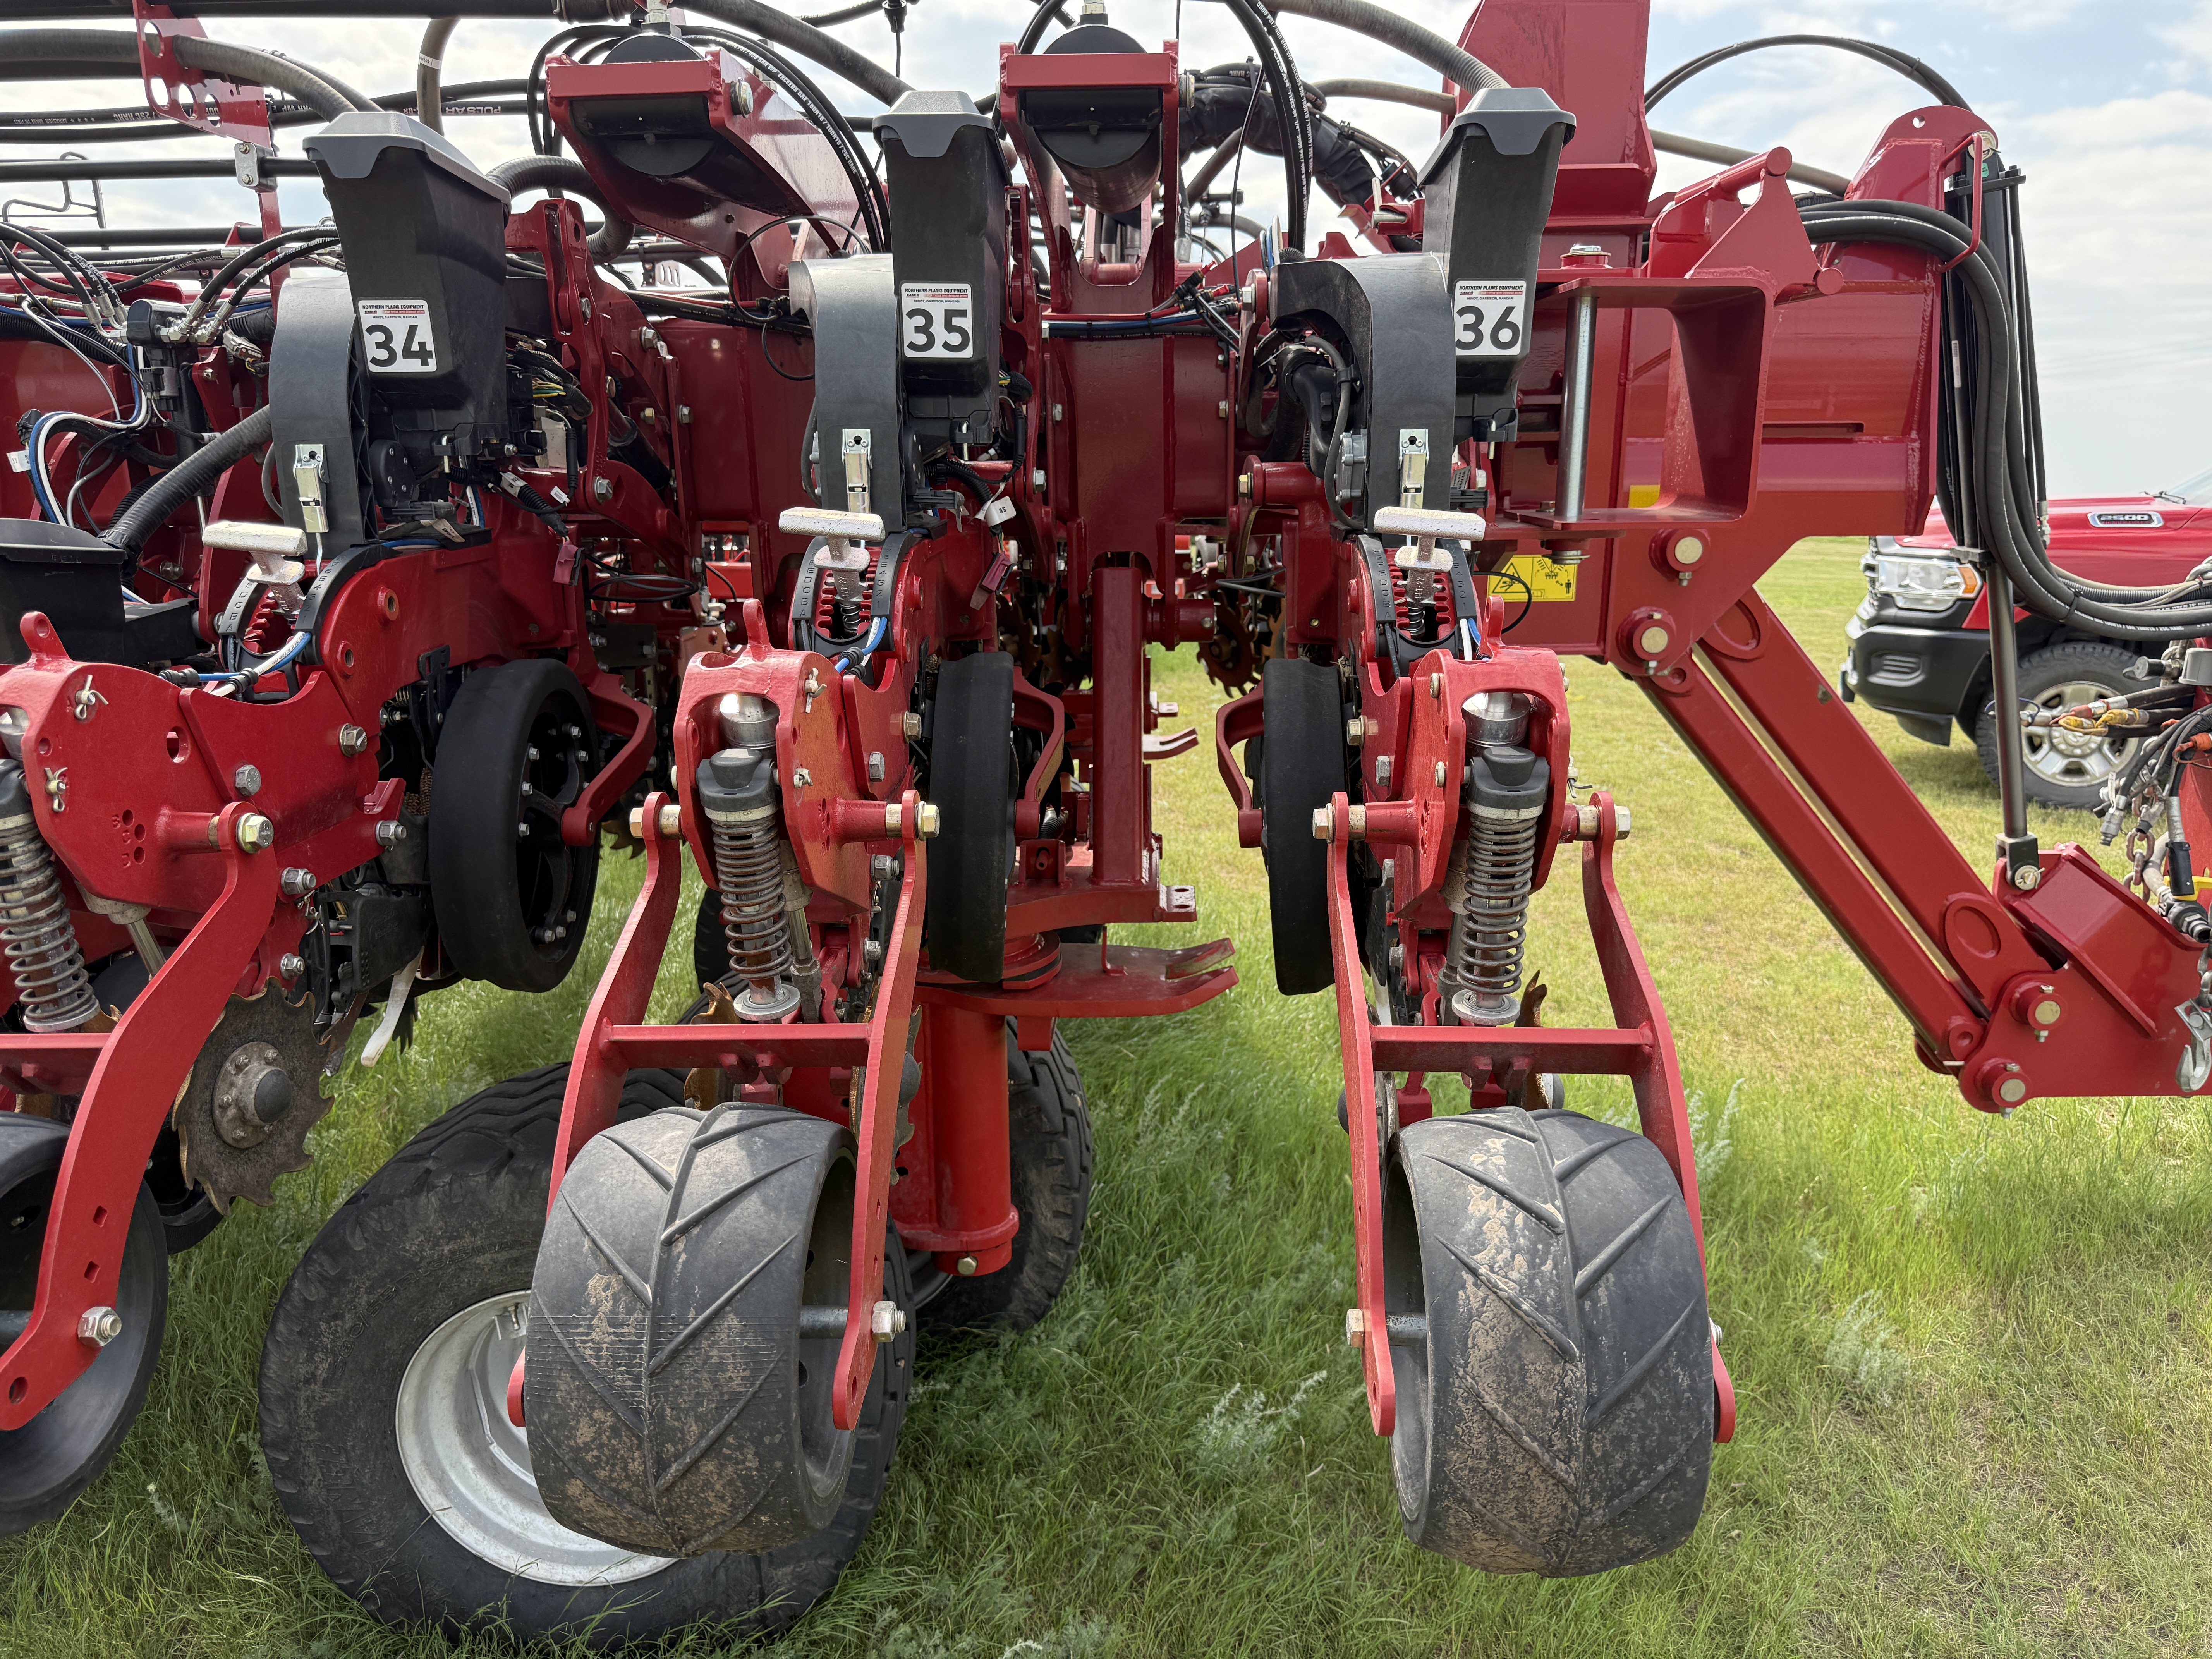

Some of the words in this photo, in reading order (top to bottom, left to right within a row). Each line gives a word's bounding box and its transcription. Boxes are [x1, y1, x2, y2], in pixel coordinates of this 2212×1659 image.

[113, 113, 133, 121] HARC
[135, 112, 151, 120] 2SC
[757, 57, 768, 67] BAR
[777, 72, 799, 93] EXCEEDS
[796, 90, 808, 103] SAE
[806, 99, 825, 123] 100R16
[840, 148, 850, 160] 2SC
[63, 249, 97, 282] PULSAR
[365, 325, 433, 367] 34
[906, 308, 970, 352] 35
[1456, 306, 1520, 350] 36
